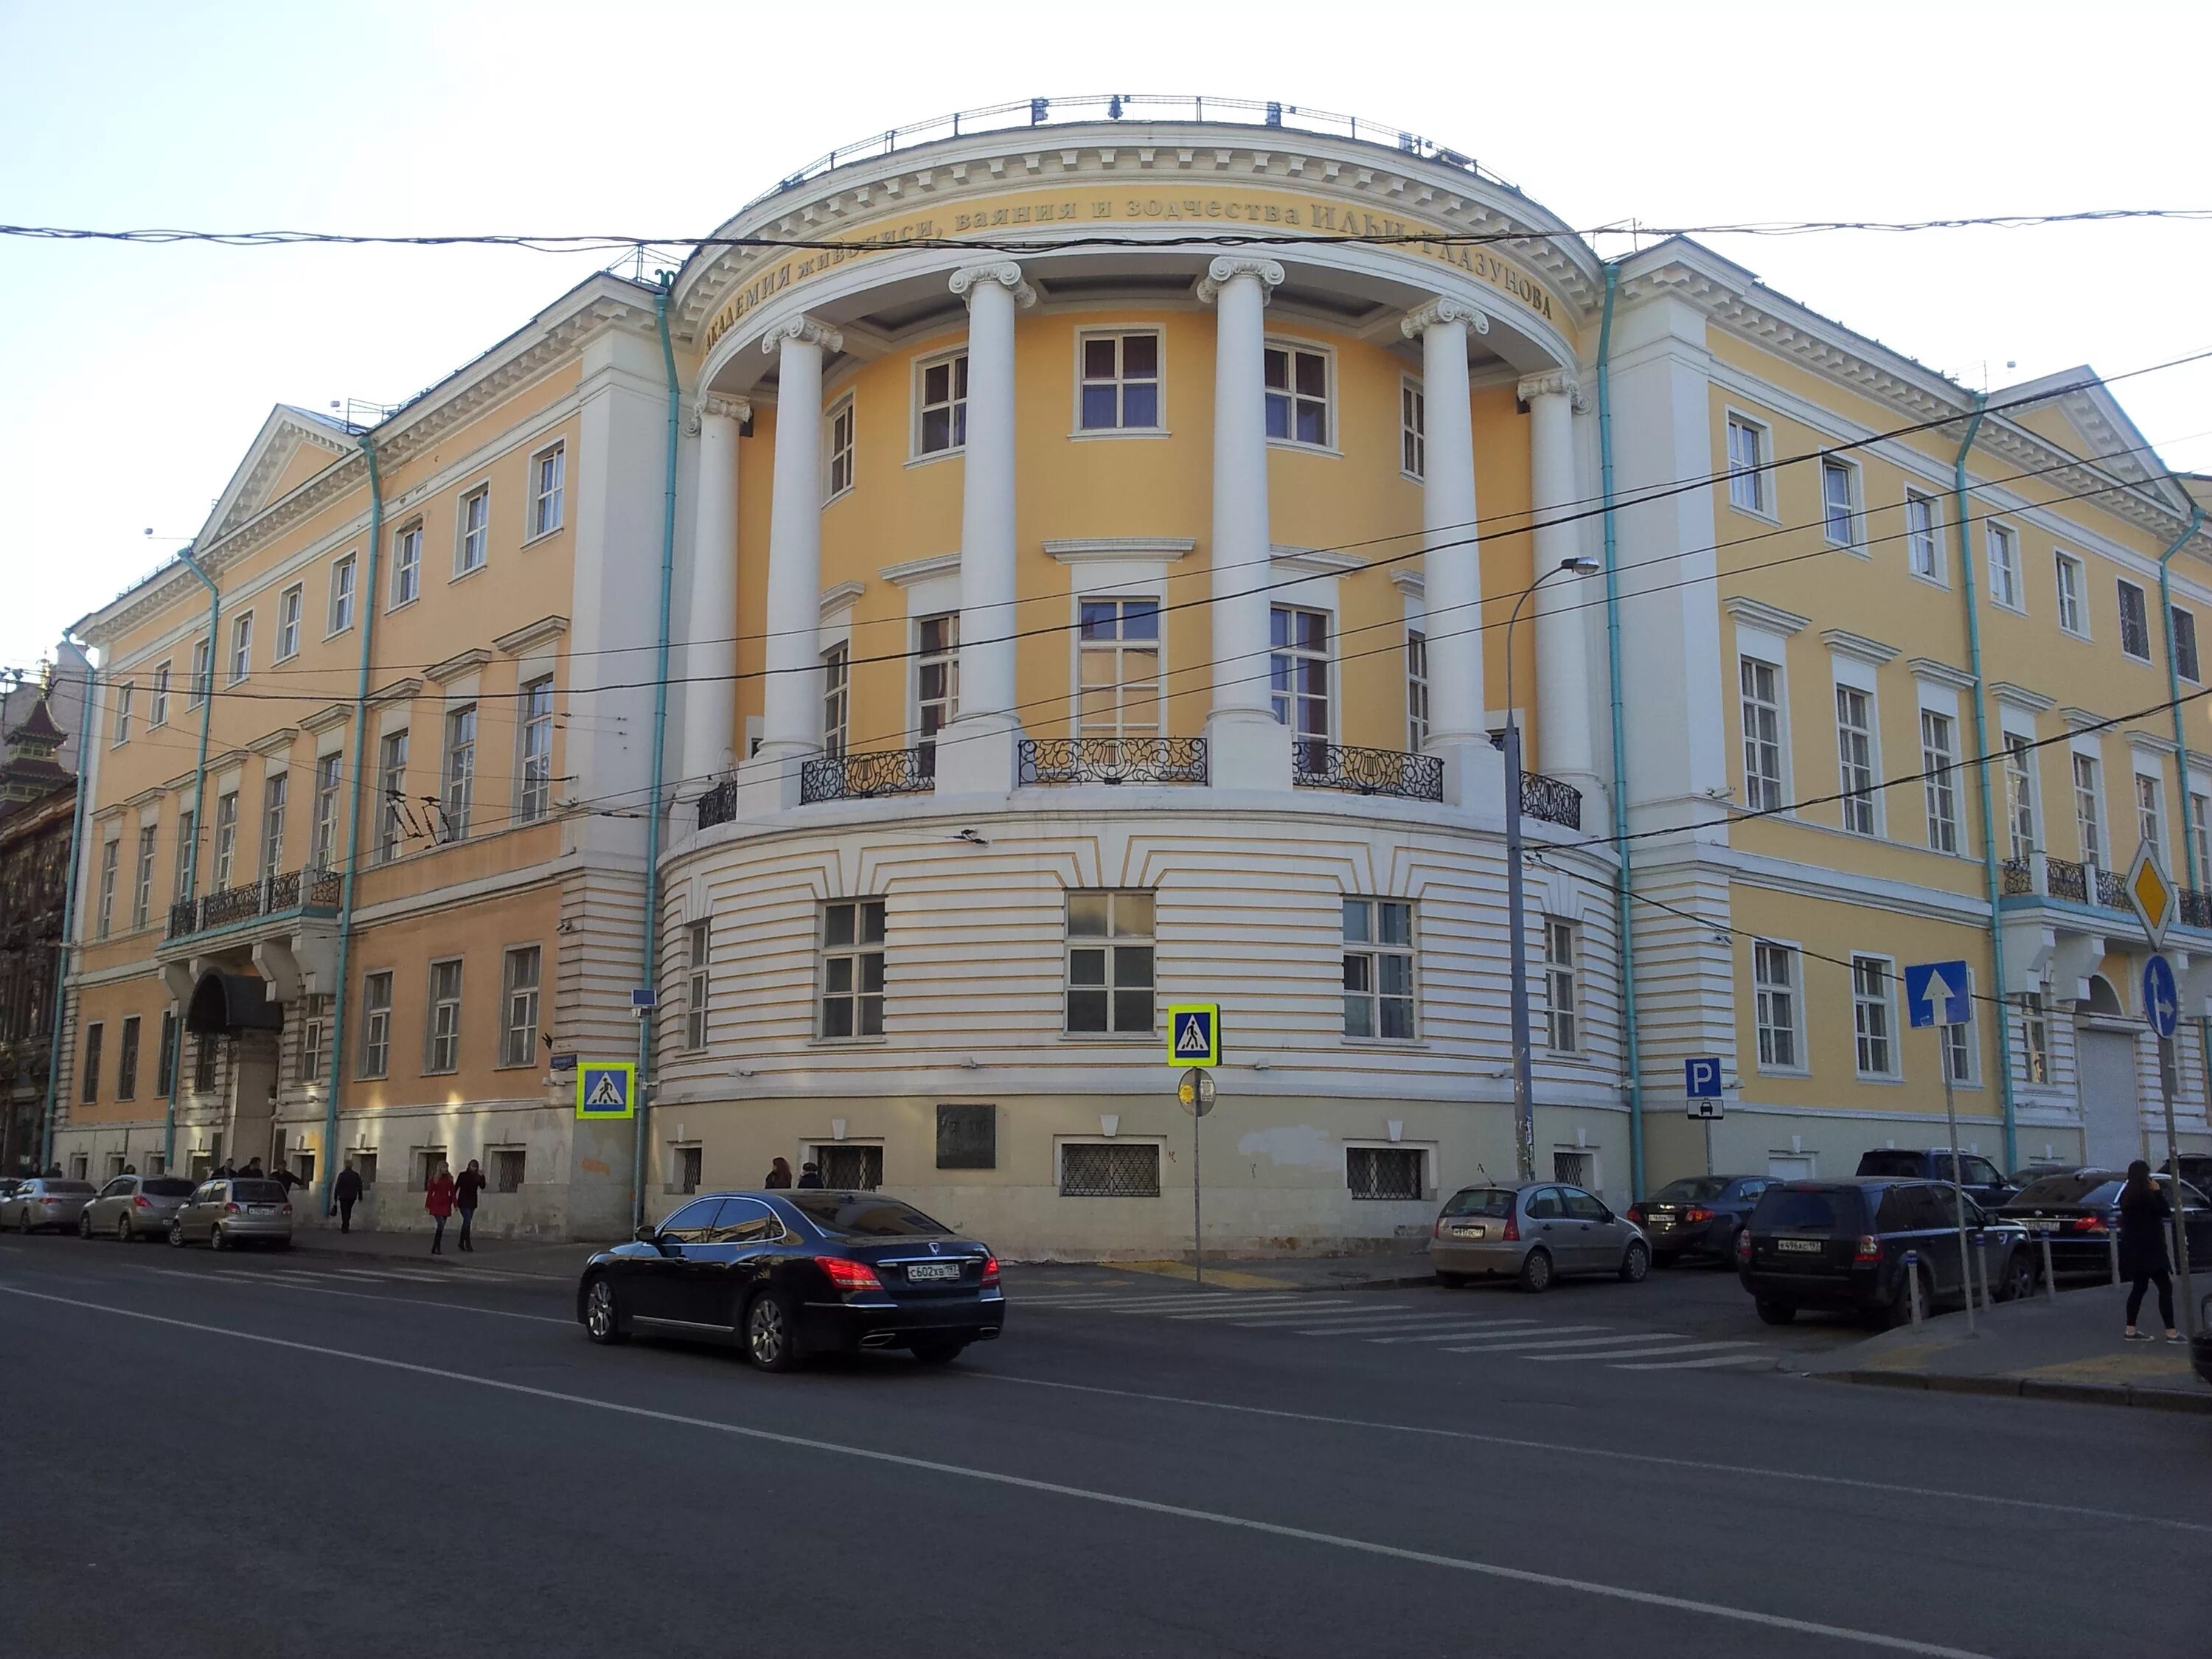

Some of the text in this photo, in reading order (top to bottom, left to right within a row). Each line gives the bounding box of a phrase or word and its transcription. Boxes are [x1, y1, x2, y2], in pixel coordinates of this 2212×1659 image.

[705, 262, 791, 355] АКАДЕМИЯ
[955, 203, 1077, 232] ваяния
[1091, 201, 1112, 219] и
[1125, 199, 1301, 226] зодчества
[1310, 204, 1406, 247] ИЛЬИ
[1692, 1062, 1712, 1093] P
